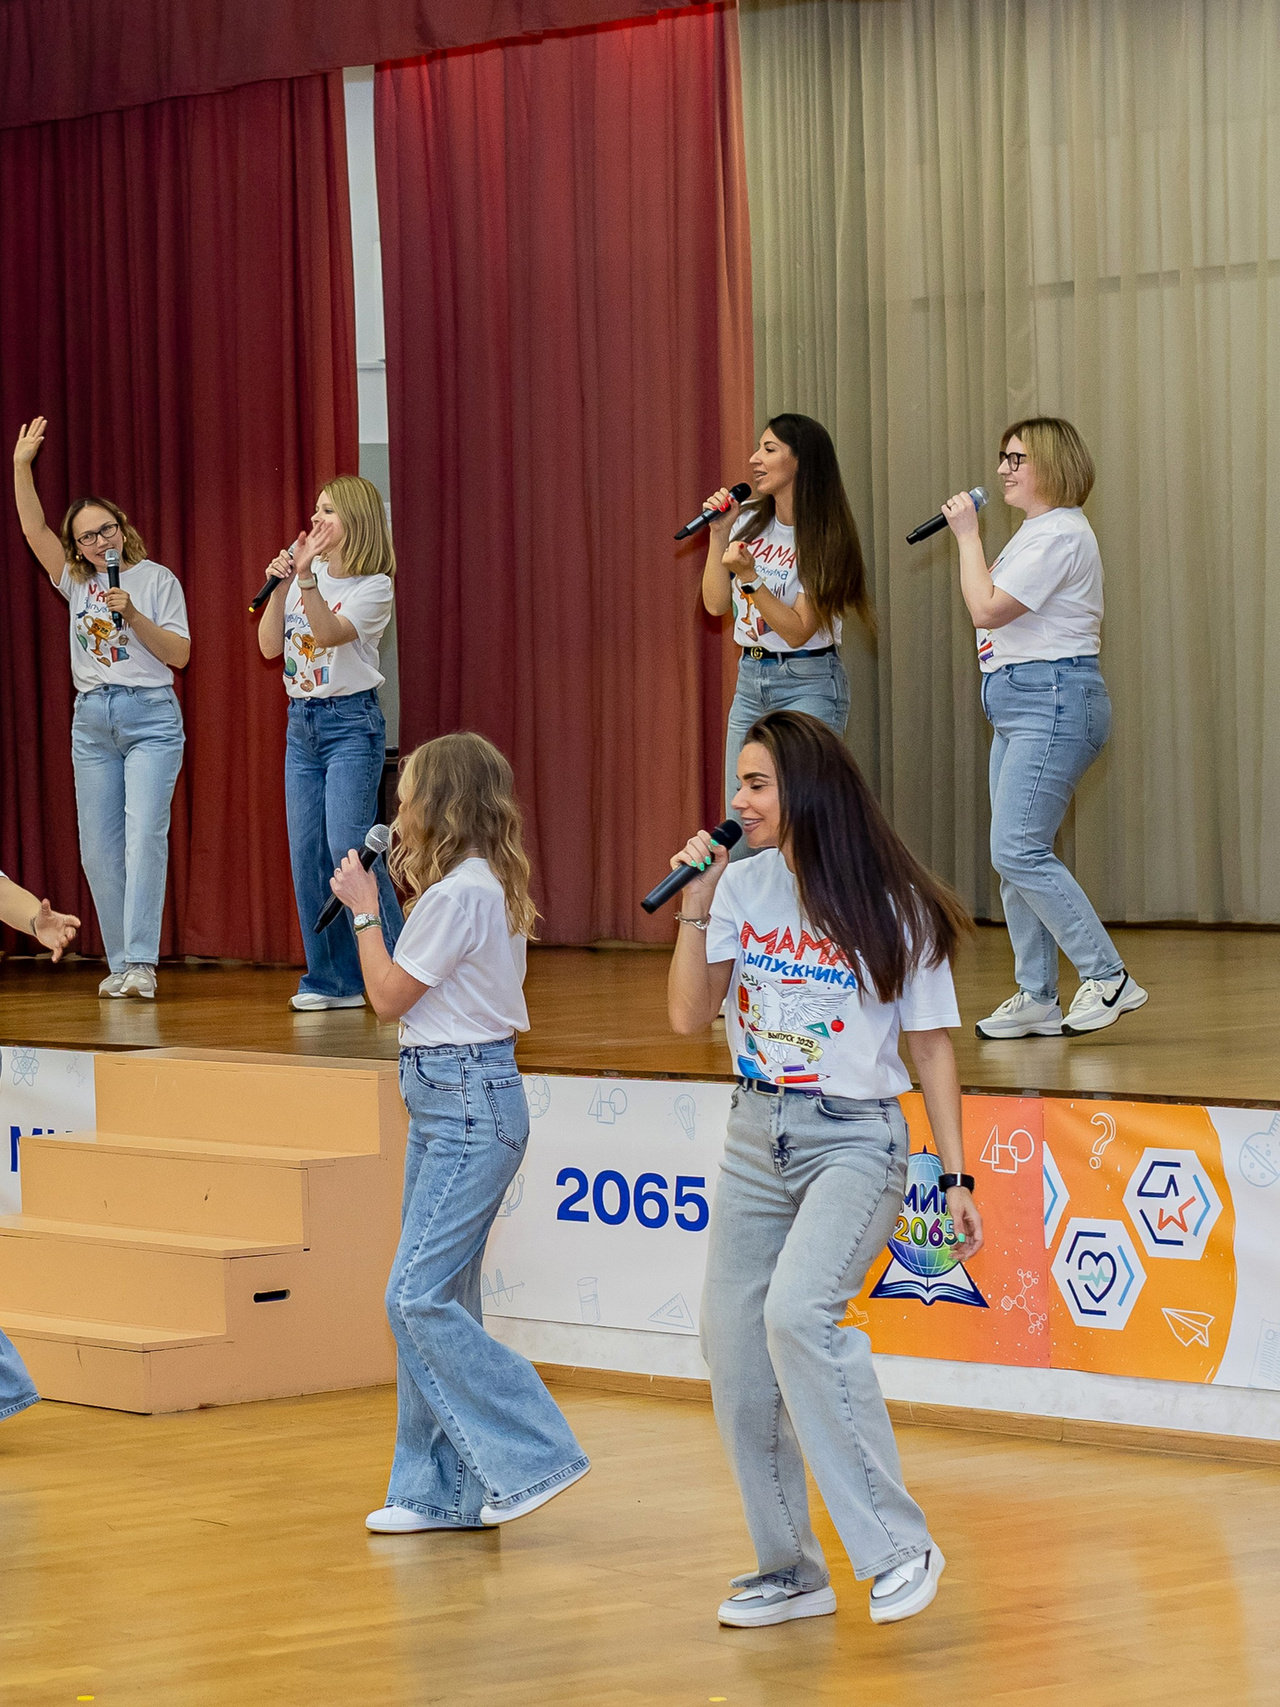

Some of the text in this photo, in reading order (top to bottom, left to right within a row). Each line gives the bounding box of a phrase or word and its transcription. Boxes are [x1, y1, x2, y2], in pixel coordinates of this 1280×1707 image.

[767, 1032, 815, 1048] ВЫПУСК 2025
[556, 1167, 710, 1232] 2065
[894, 1216, 959, 1248] 2065
